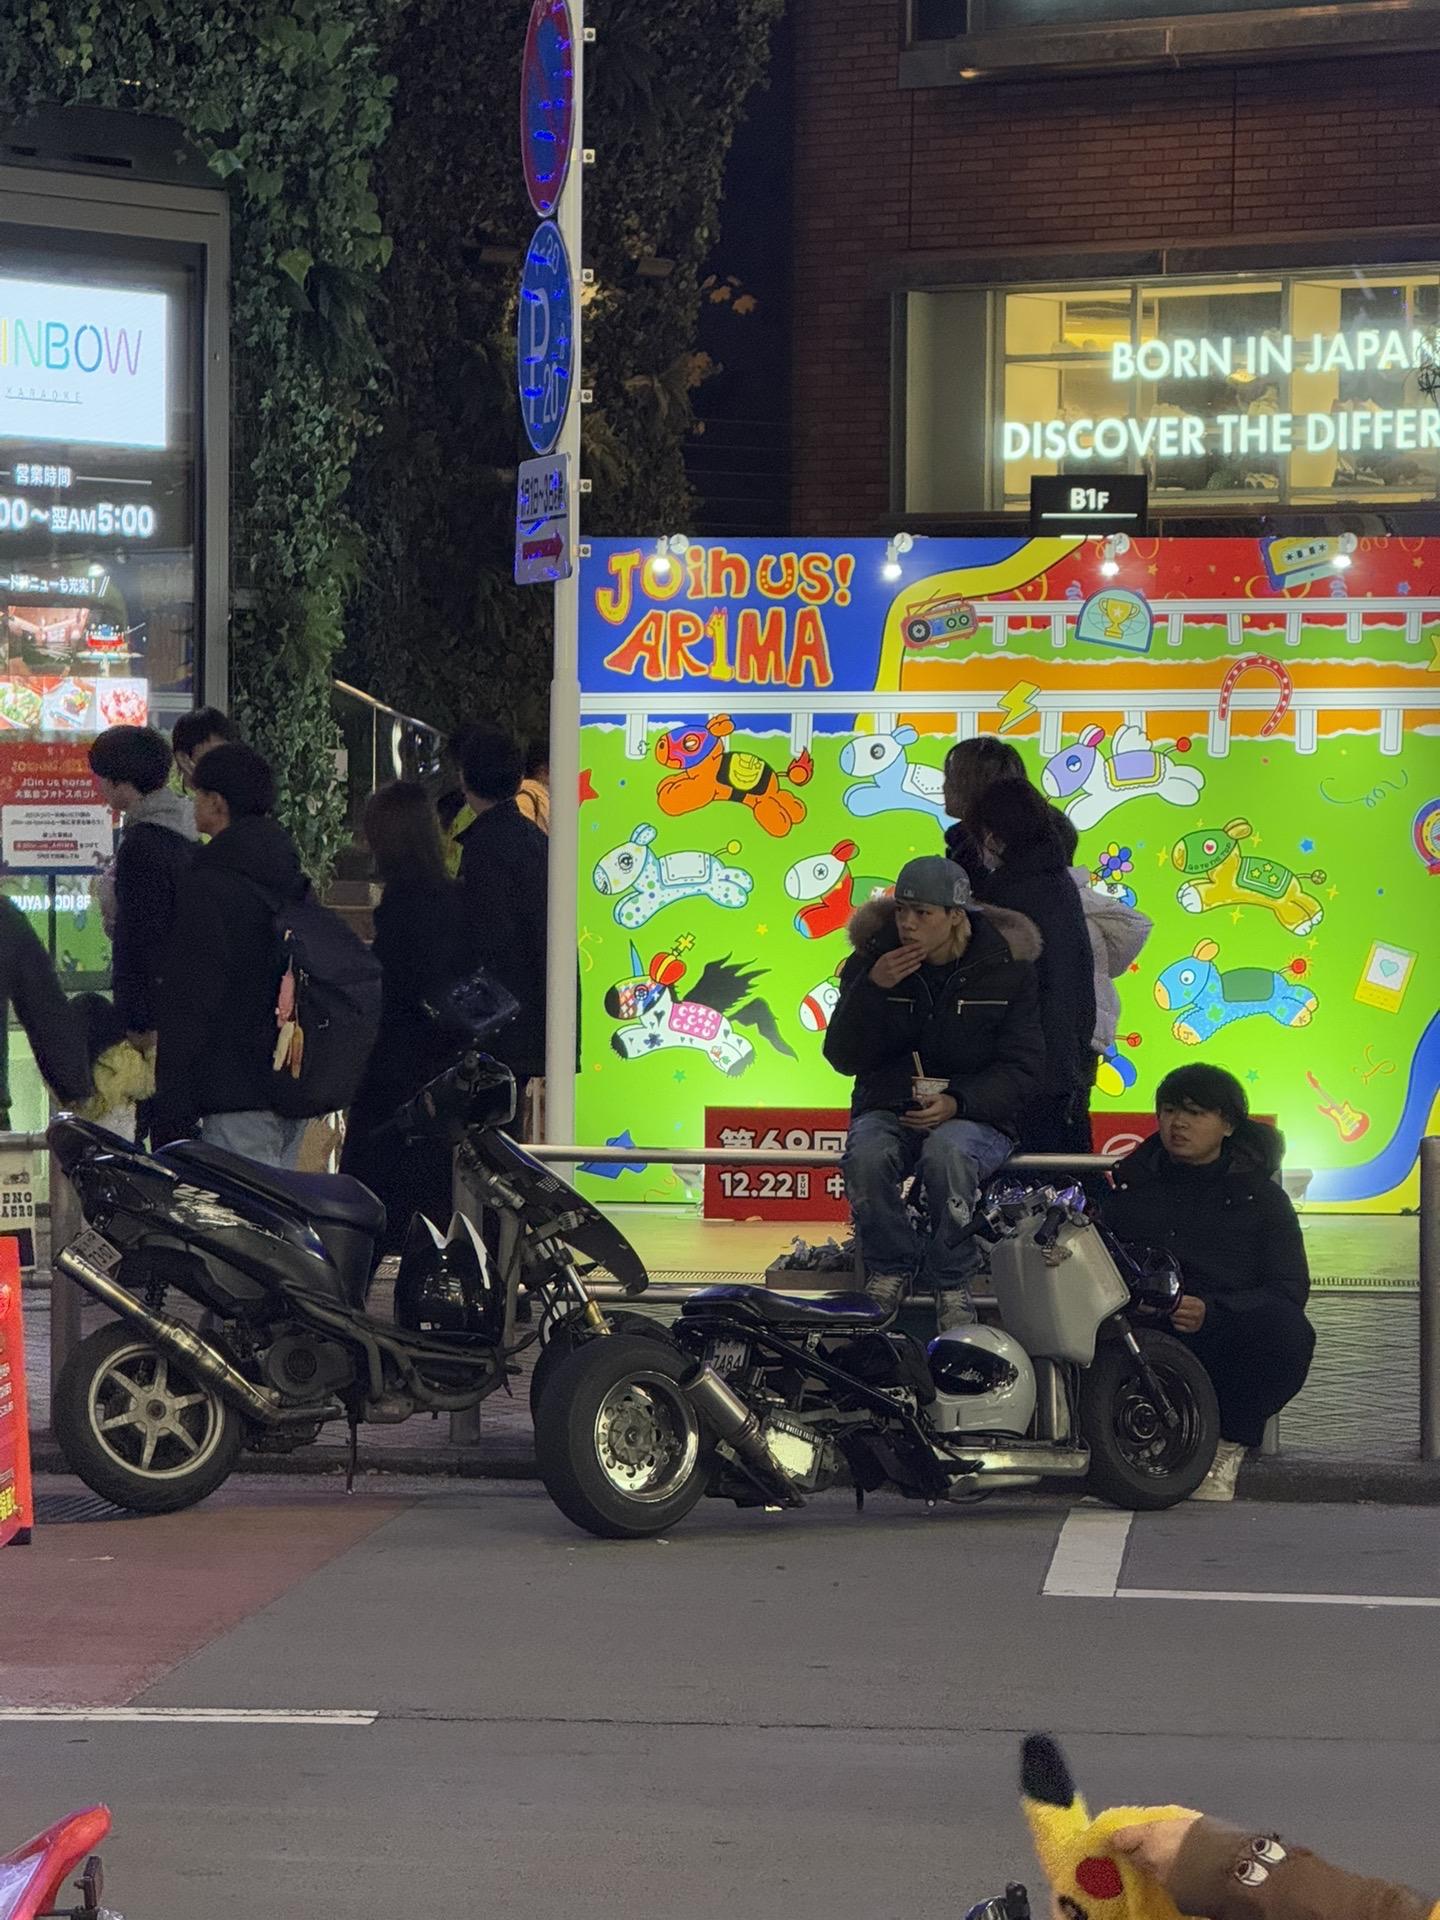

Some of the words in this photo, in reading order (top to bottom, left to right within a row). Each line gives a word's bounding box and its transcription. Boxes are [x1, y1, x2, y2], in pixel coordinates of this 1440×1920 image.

[1, 319, 142, 376] INBOW
[529, 288, 550, 424] P
[1111, 336, 1232, 382] BORN
[1246, 334, 1293, 375] IN
[1304, 328, 1440, 373] JAPAN
[6, 386, 82, 401] KARAOKE
[1003, 416, 1206, 460] DISCOVER
[1217, 413, 1292, 454] THE
[1306, 408, 1440, 452] DIFFER
[15, 463, 72, 488] 営業時間
[1070, 487, 1110, 511] B1F
[720, 1172, 793, 1198] 12.22
